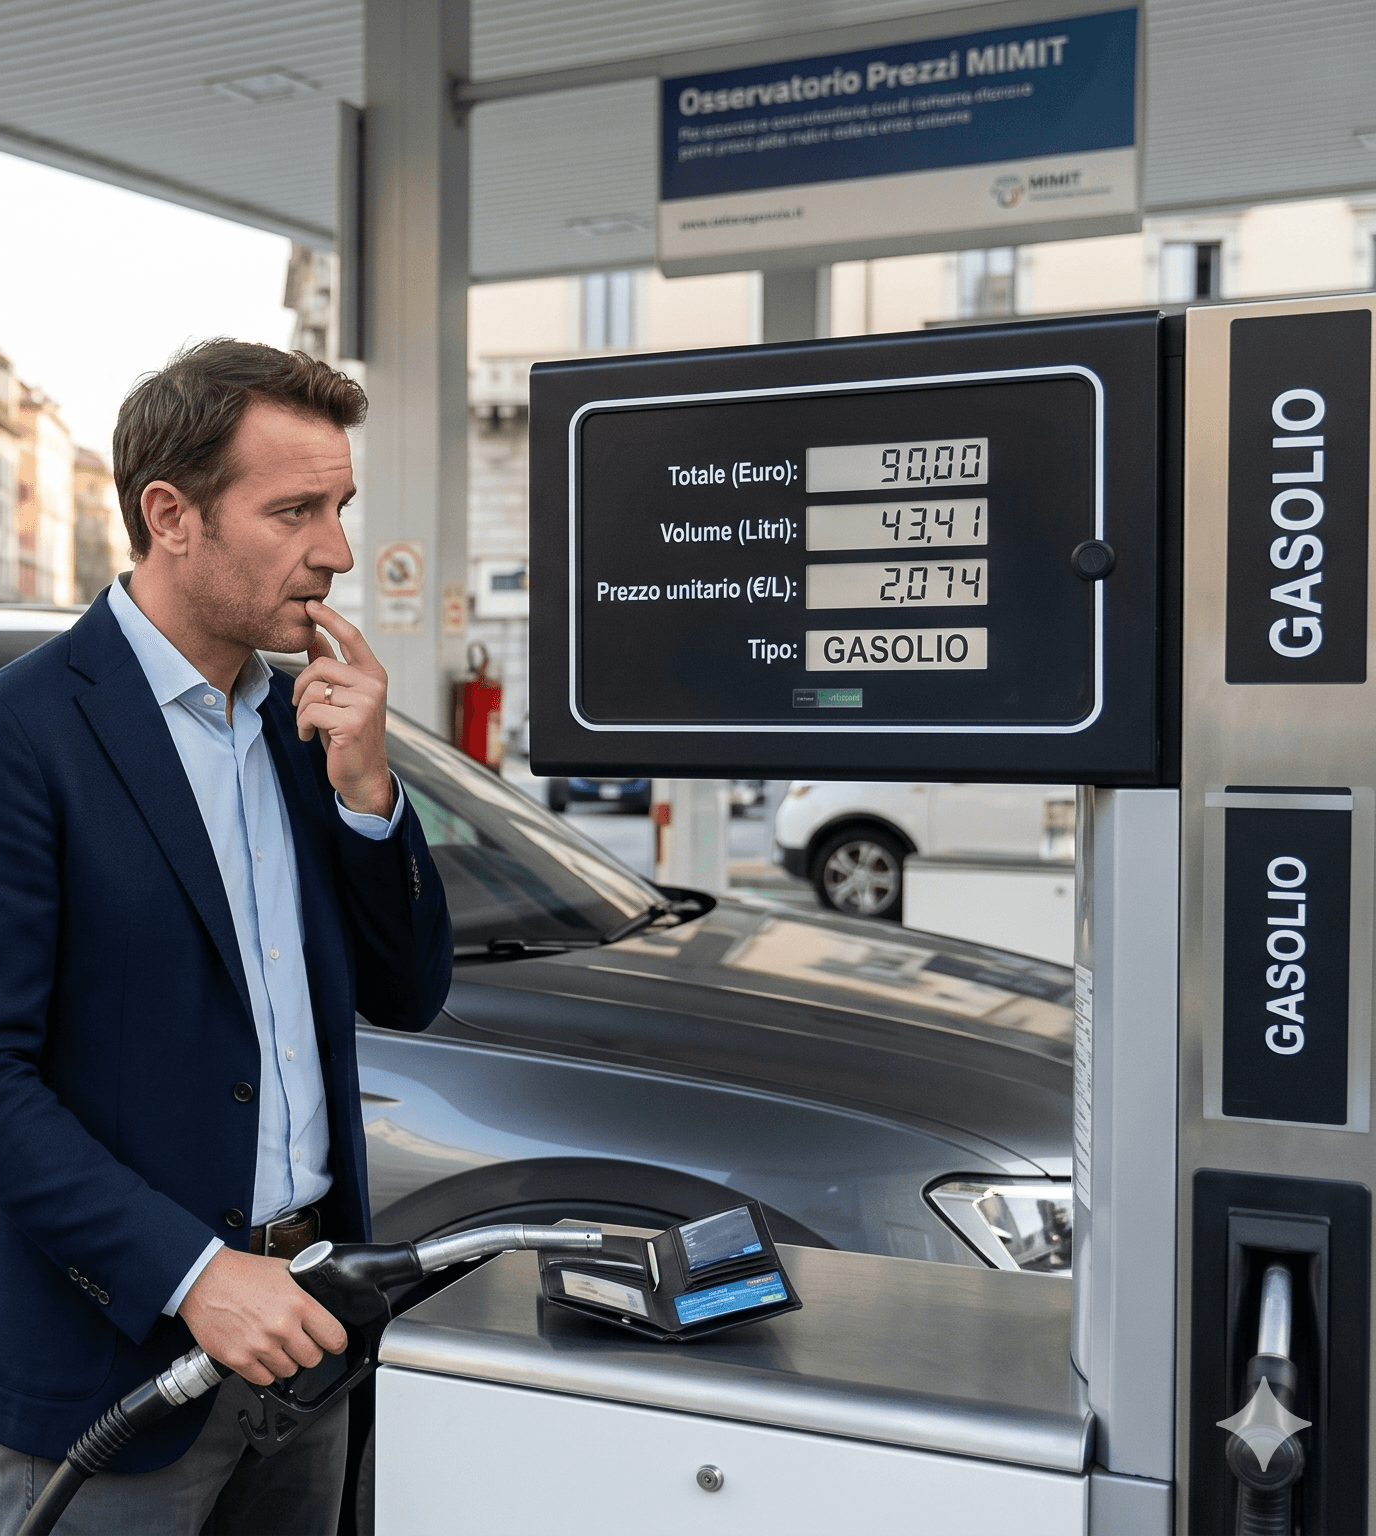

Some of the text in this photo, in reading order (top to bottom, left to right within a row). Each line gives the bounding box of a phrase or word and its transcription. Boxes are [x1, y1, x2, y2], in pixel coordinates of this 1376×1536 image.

[679, 68, 862, 116] Osservatorio
[866, 50, 960, 91] Prezzi
[966, 35, 1069, 77] MIMIT
[1029, 170, 1082, 190] MIMIT
[668, 460, 799, 489] Totale (Euro):
[880, 444, 982, 485] 90,00
[660, 518, 798, 547] Volume (Litri):
[881, 505, 982, 544] 43,41
[1268, 387, 1326, 659] GASOLIO
[597, 576, 798, 604] Prezzo unitario (€/L):
[880, 565, 982, 604] 2,074
[747, 638, 798, 665] Tipo:
[823, 634, 970, 664] GASOLIO
[1265, 856, 1308, 1056] GASOLIO
